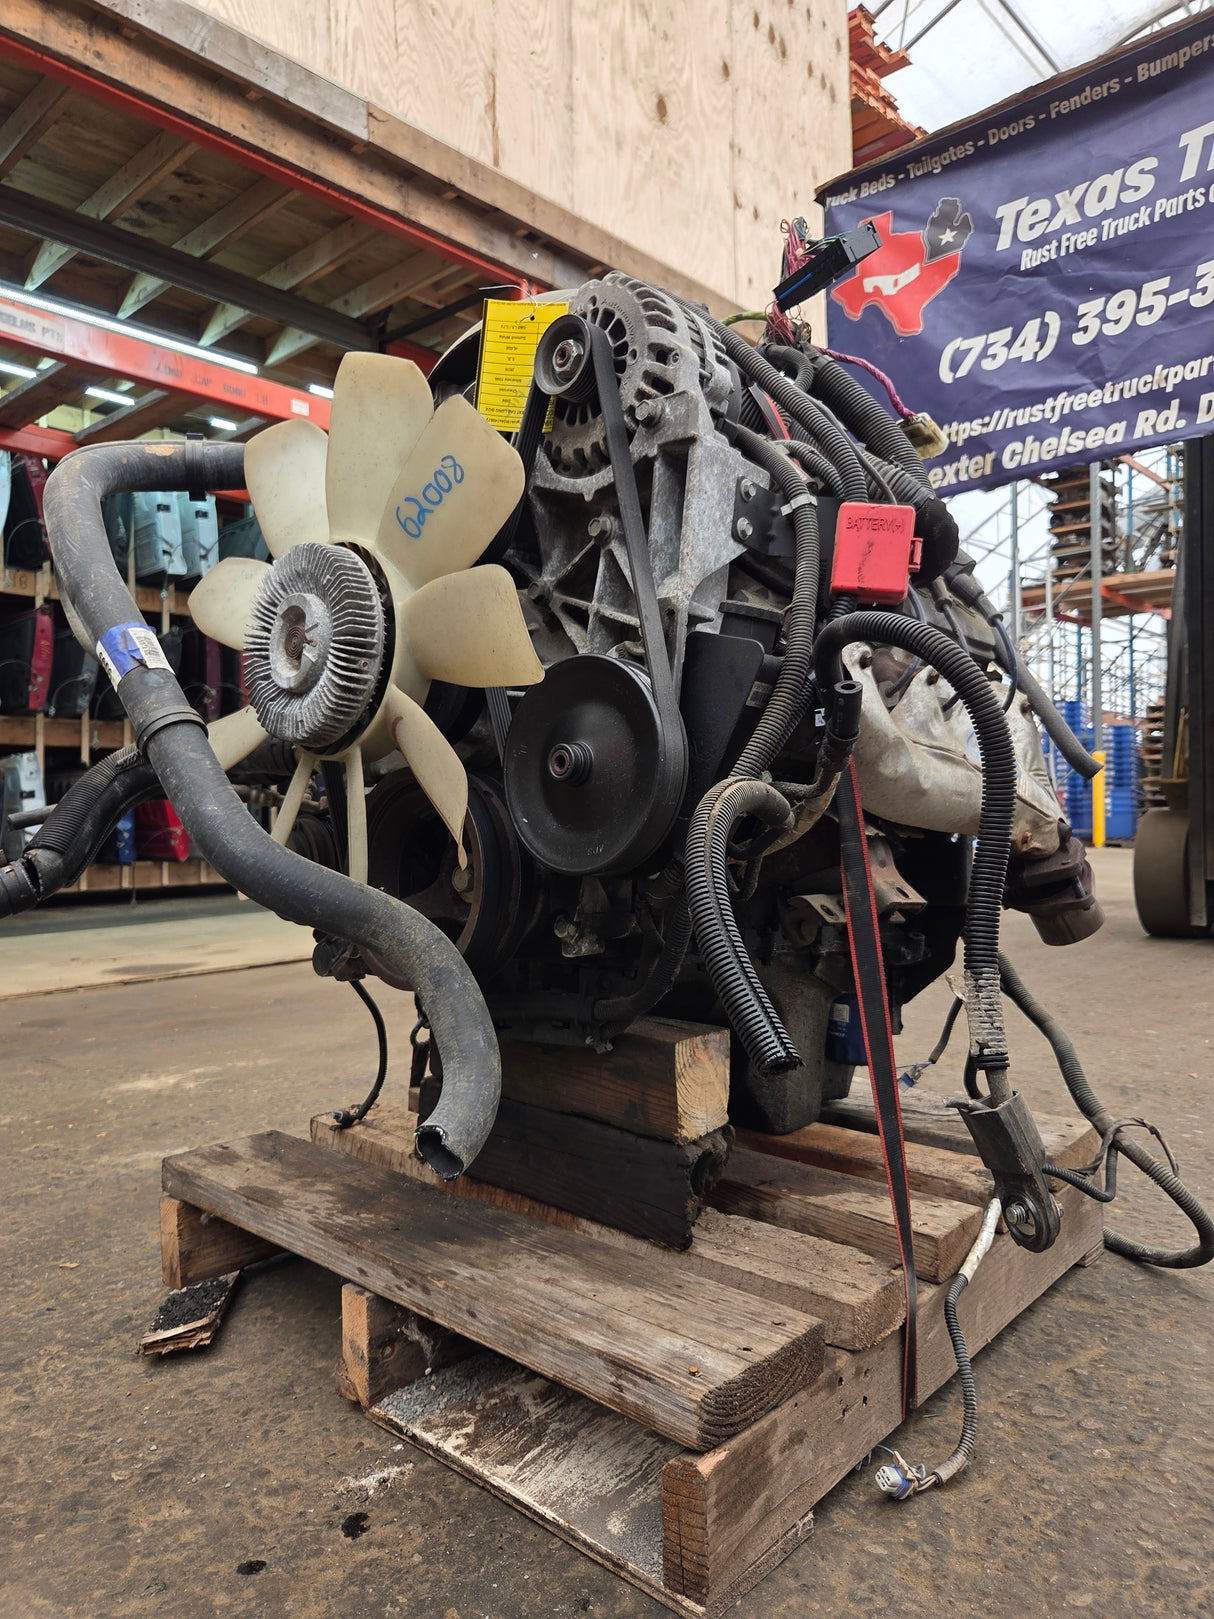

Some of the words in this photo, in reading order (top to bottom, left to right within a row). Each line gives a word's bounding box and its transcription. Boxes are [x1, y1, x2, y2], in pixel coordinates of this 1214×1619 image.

[825, 186, 859, 212] ruck
[860, 173, 896, 199] Beds
[907, 141, 975, 180] Tailgates
[988, 115, 1035, 146] Doors
[1050, 78, 1120, 119] Fenders
[995, 156, 1159, 252] Texas
[1178, 120, 1214, 183] T
[1020, 239, 1058, 271] Rust
[1060, 227, 1098, 257] Free
[1101, 205, 1152, 241] Truck
[1153, 187, 1206, 223] Parts
[938, 311, 1061, 384] (734)
[1072, 260, 1214, 345] 395-3
[928, 450, 997, 490] exter
[1002, 421, 1127, 470] Chelsea
[1133, 398, 1187, 440] Rd.
[942, 355, 1214, 447] ttps://rustfreetruckpar
[395, 454, 465, 539] 62008
